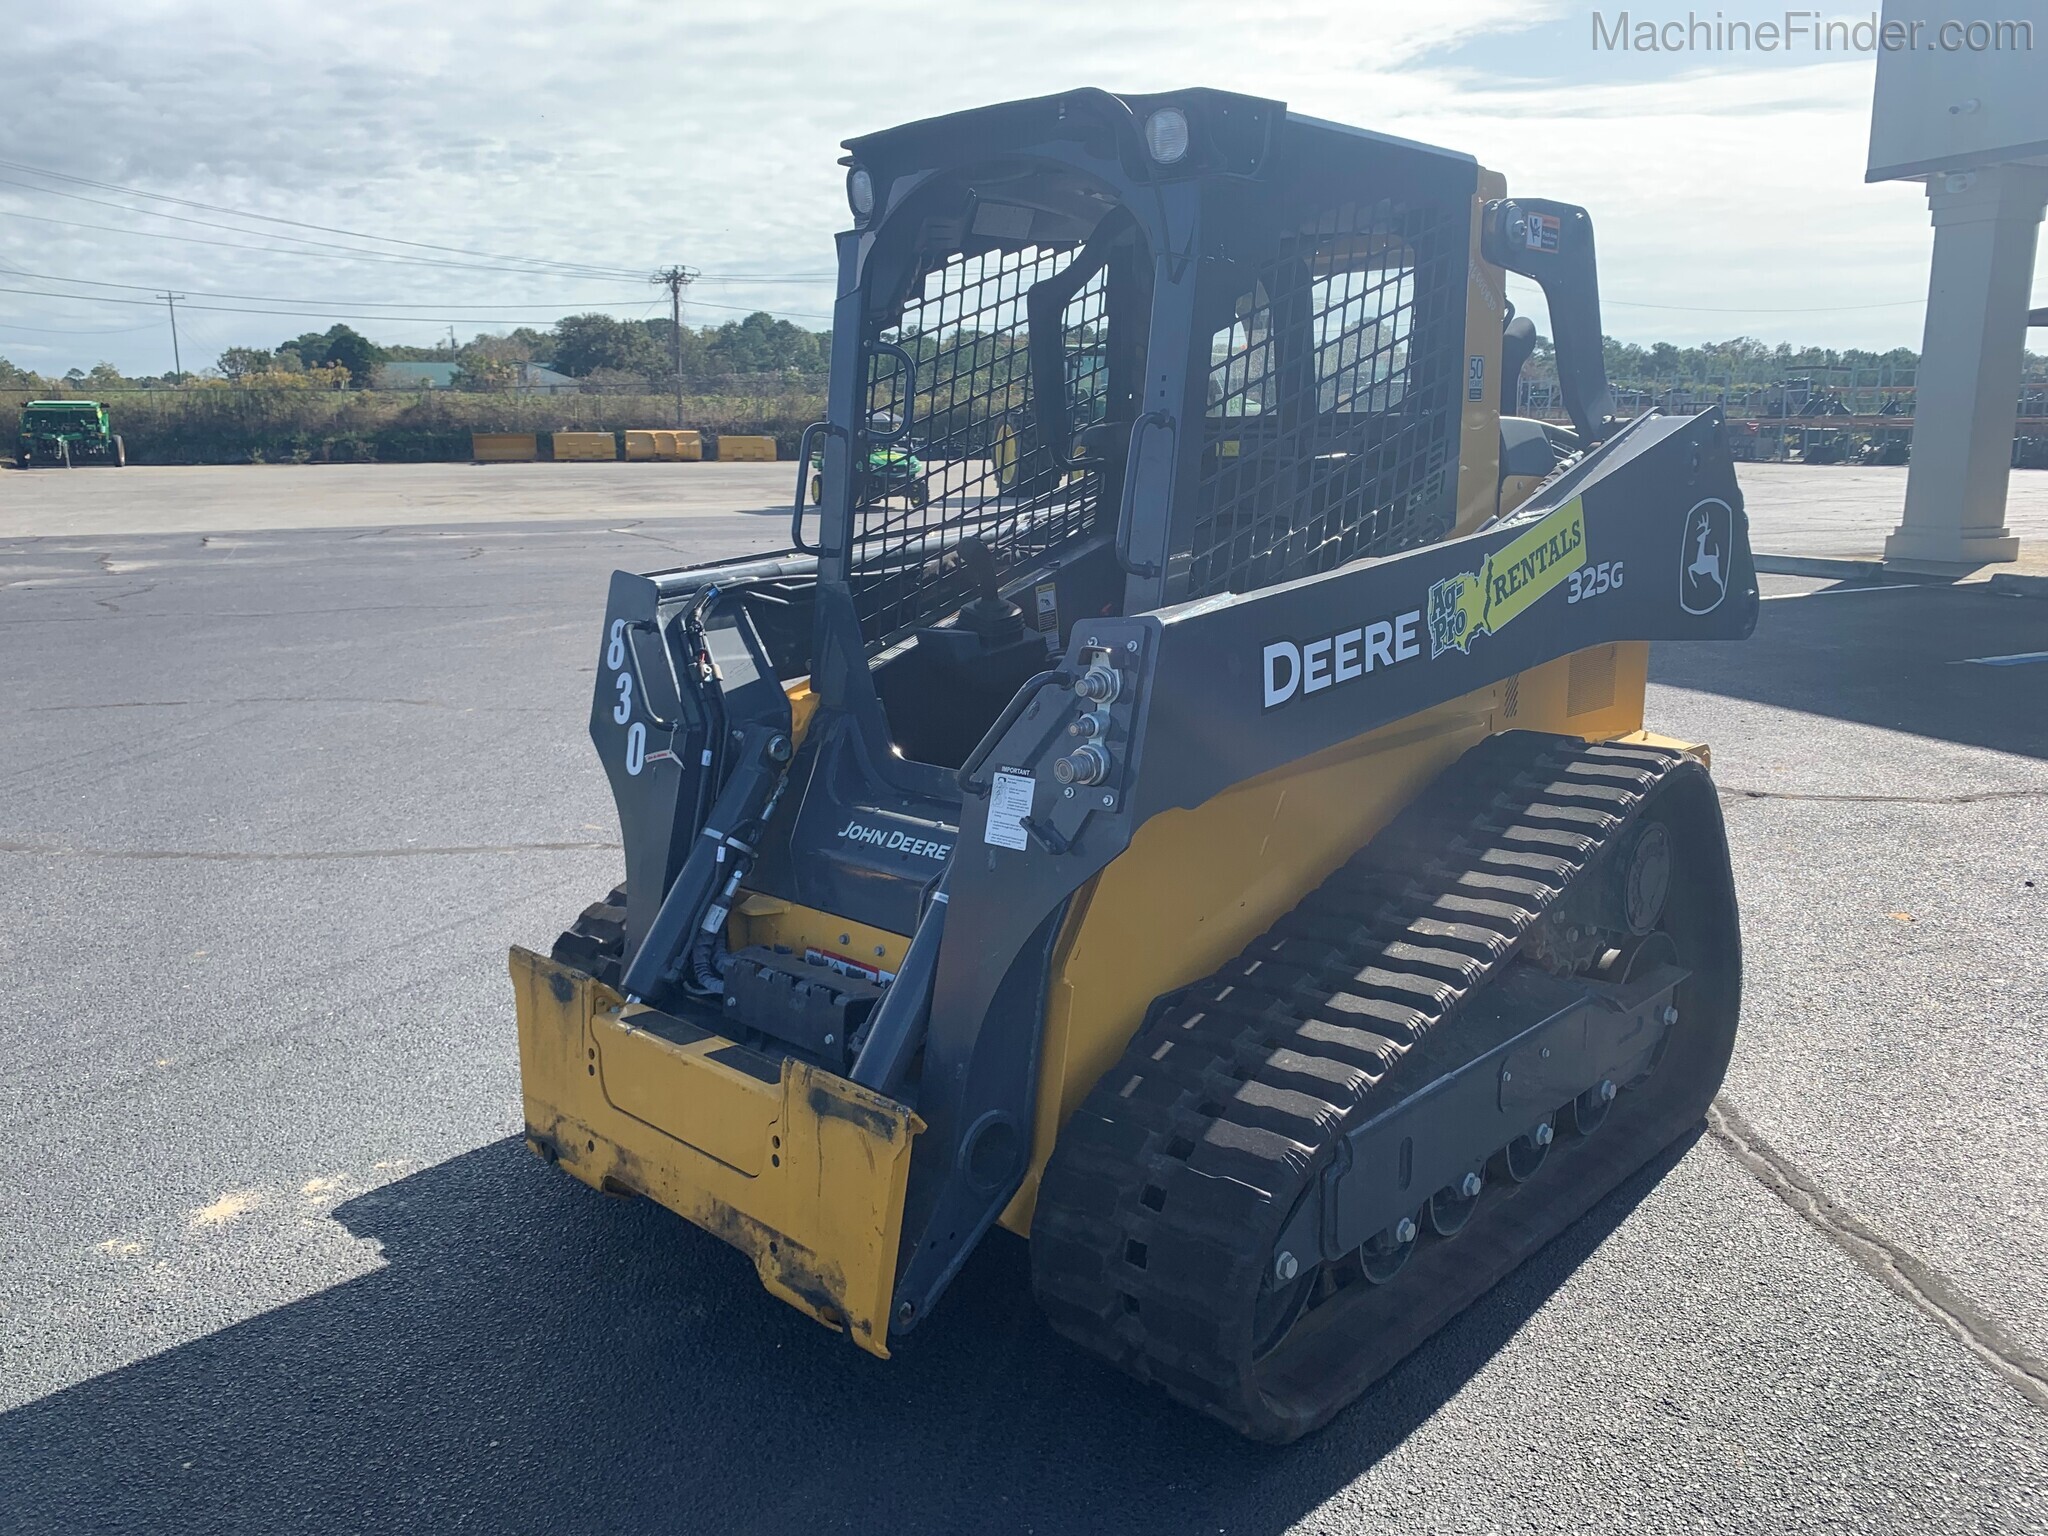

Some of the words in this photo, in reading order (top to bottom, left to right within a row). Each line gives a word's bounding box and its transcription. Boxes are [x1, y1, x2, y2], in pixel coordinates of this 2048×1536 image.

[1470, 358, 1483, 379] 50
[1493, 520, 1581, 607] RENTALS
[1567, 561, 1624, 604] 325G
[1432, 608, 1467, 653] Pro
[1264, 609, 1420, 708] DEERE
[607, 618, 646, 776] 830
[1001, 766, 1031, 776] IMPORTANT
[838, 821, 889, 847] JOHN
[886, 830, 952, 861] DEERE
